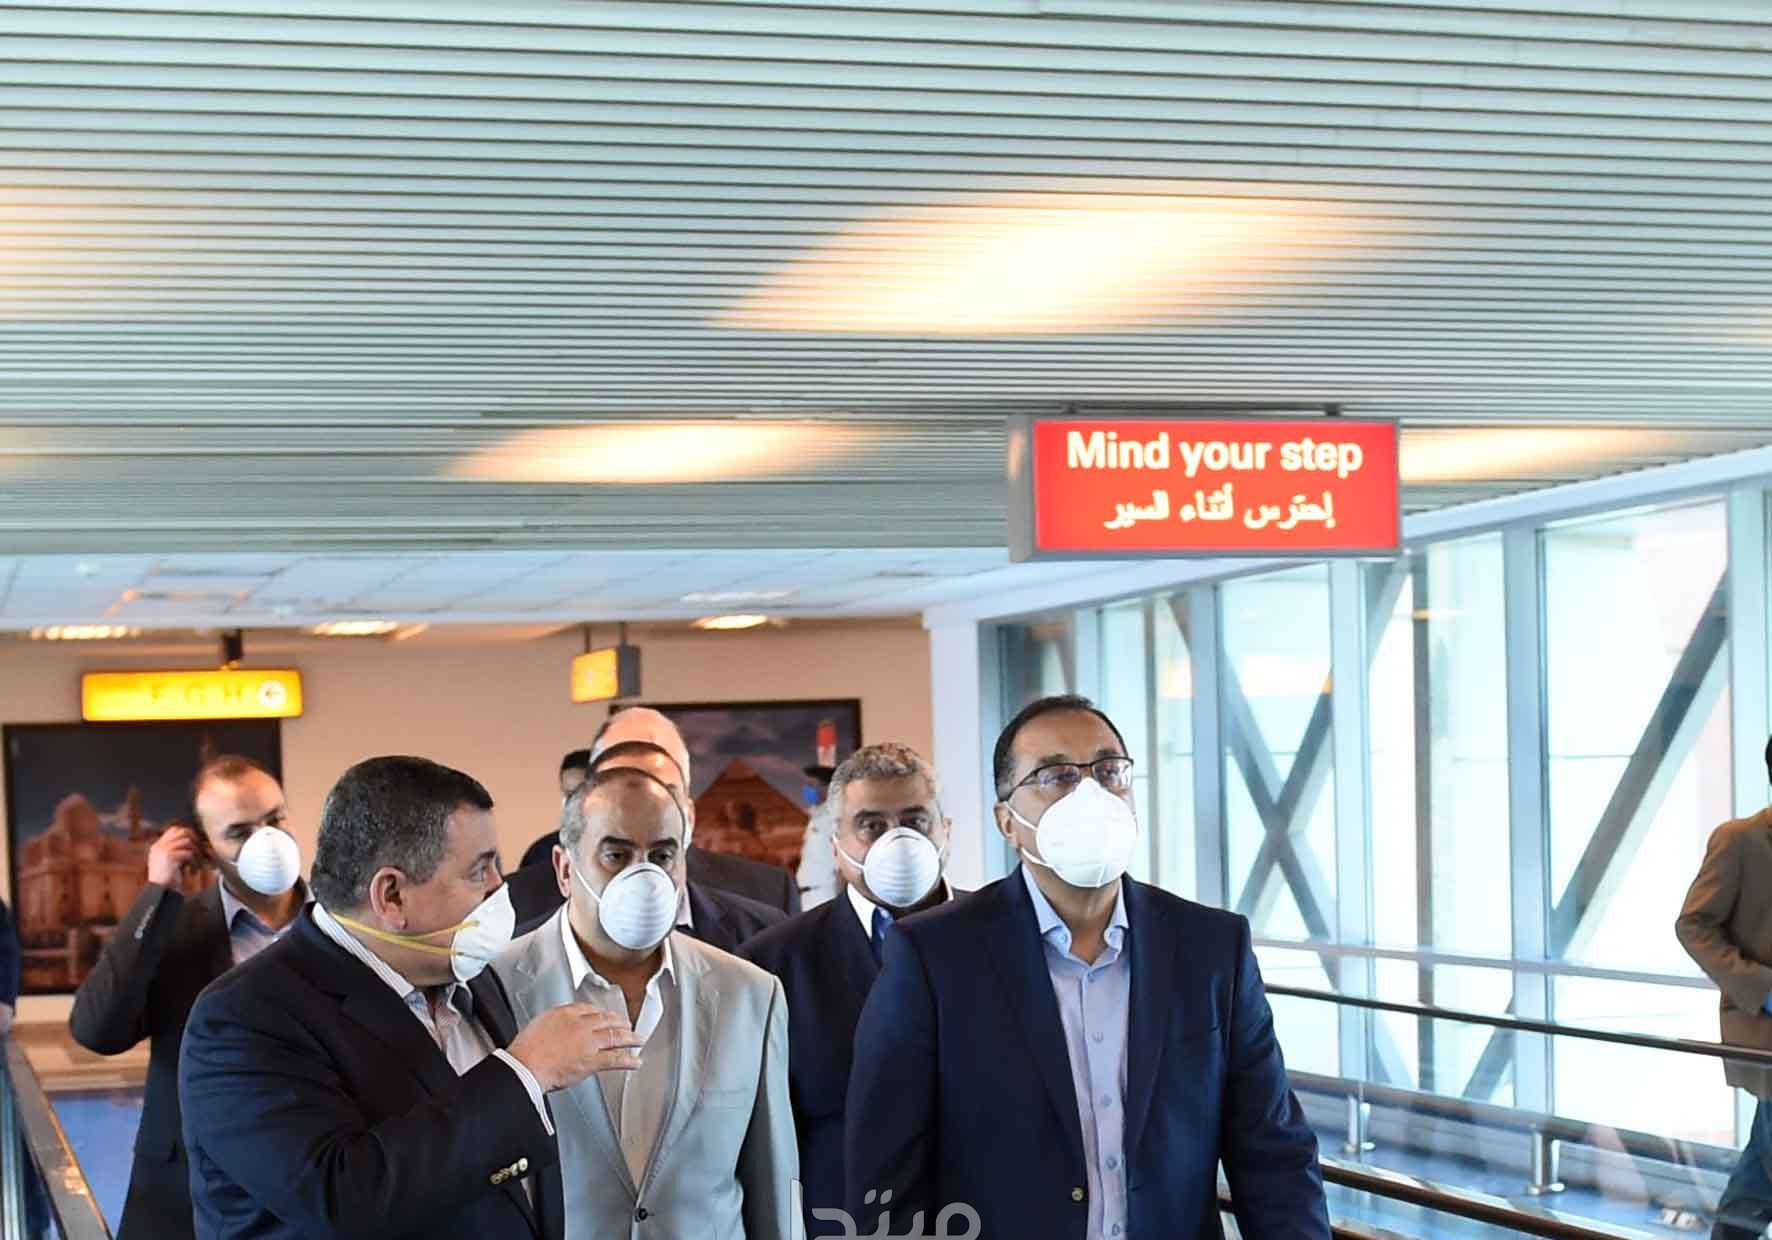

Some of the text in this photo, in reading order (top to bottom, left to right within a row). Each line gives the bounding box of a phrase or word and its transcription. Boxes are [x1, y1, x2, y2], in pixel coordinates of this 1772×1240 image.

[1066, 431, 1363, 478] Mind your step
[1103, 482, 1336, 529] إحترس أثناء السير
